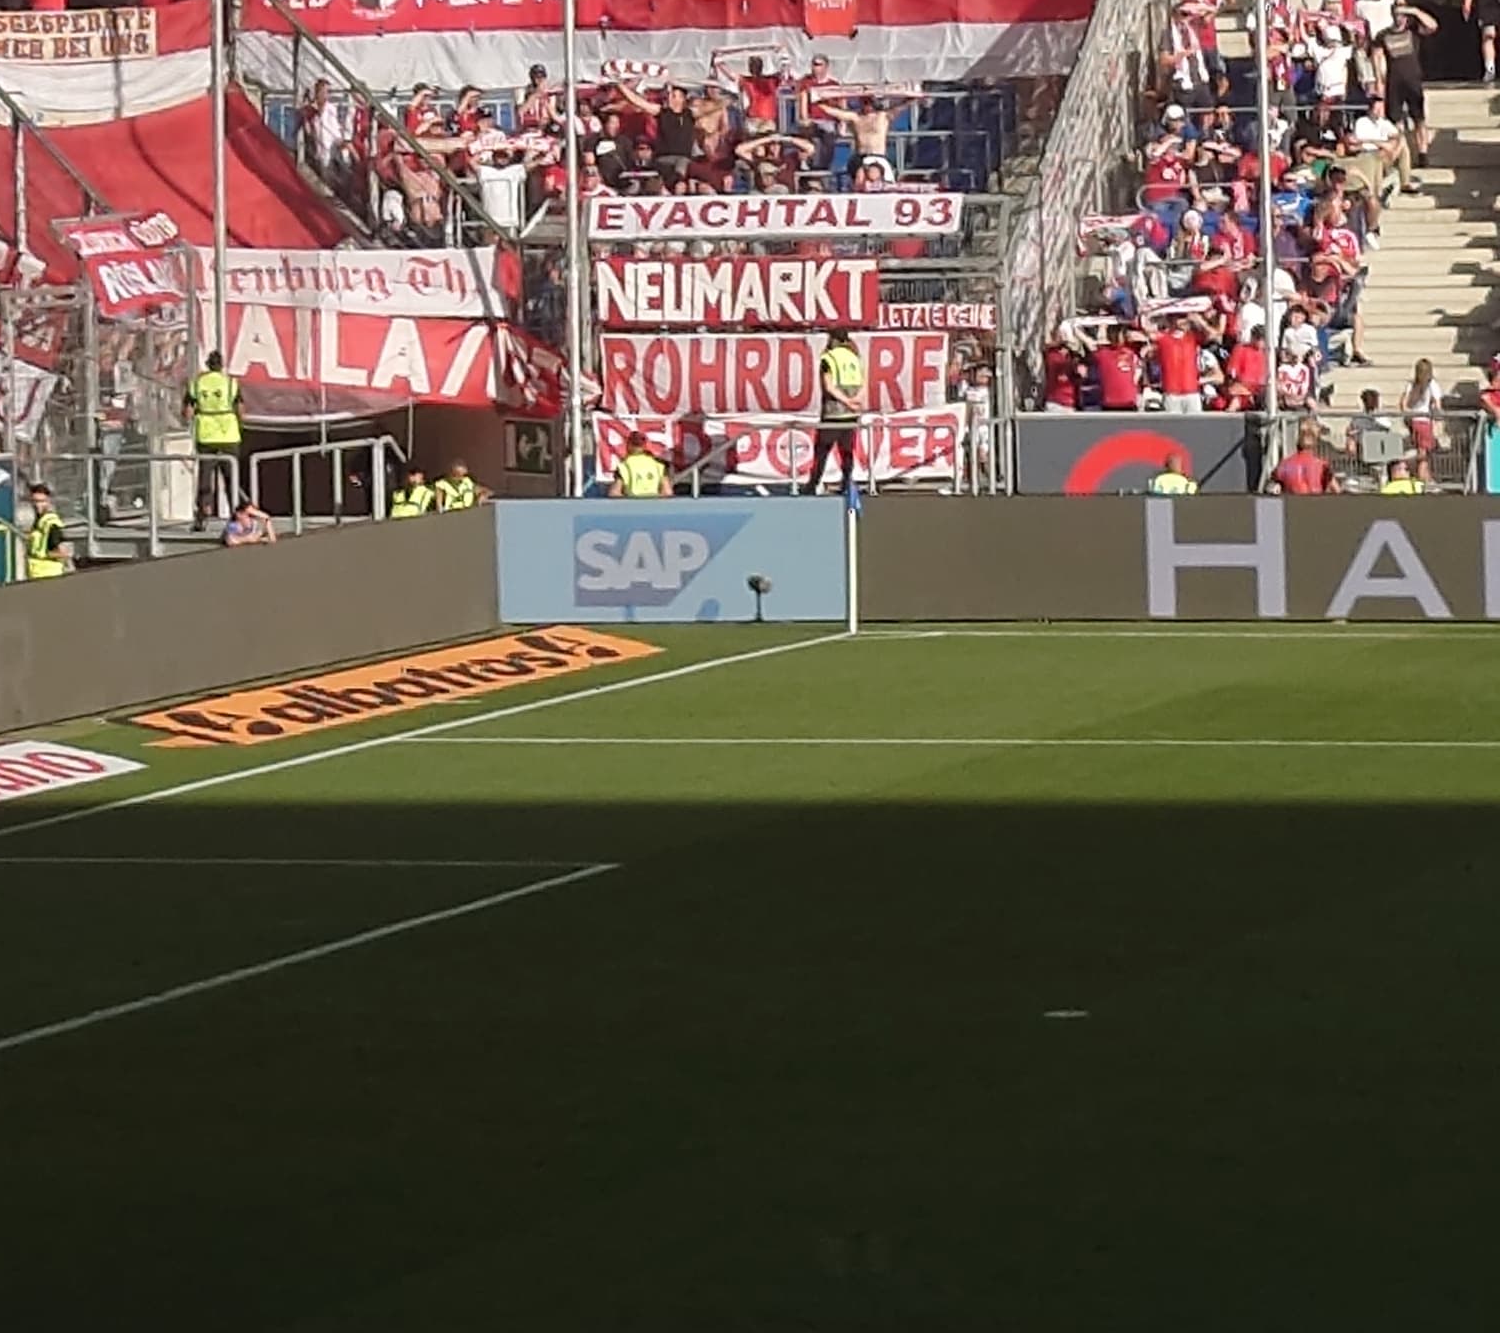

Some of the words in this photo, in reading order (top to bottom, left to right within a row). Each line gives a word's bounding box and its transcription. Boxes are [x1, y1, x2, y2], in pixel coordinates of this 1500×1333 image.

[596, 198, 872, 231] EYACHTAL
[893, 197, 954, 227] 93
[596, 258, 878, 323] NEUMARKT
[605, 336, 945, 416] ROHRDRF
[576, 530, 710, 591] SAP
[260, 647, 558, 725] albatros
